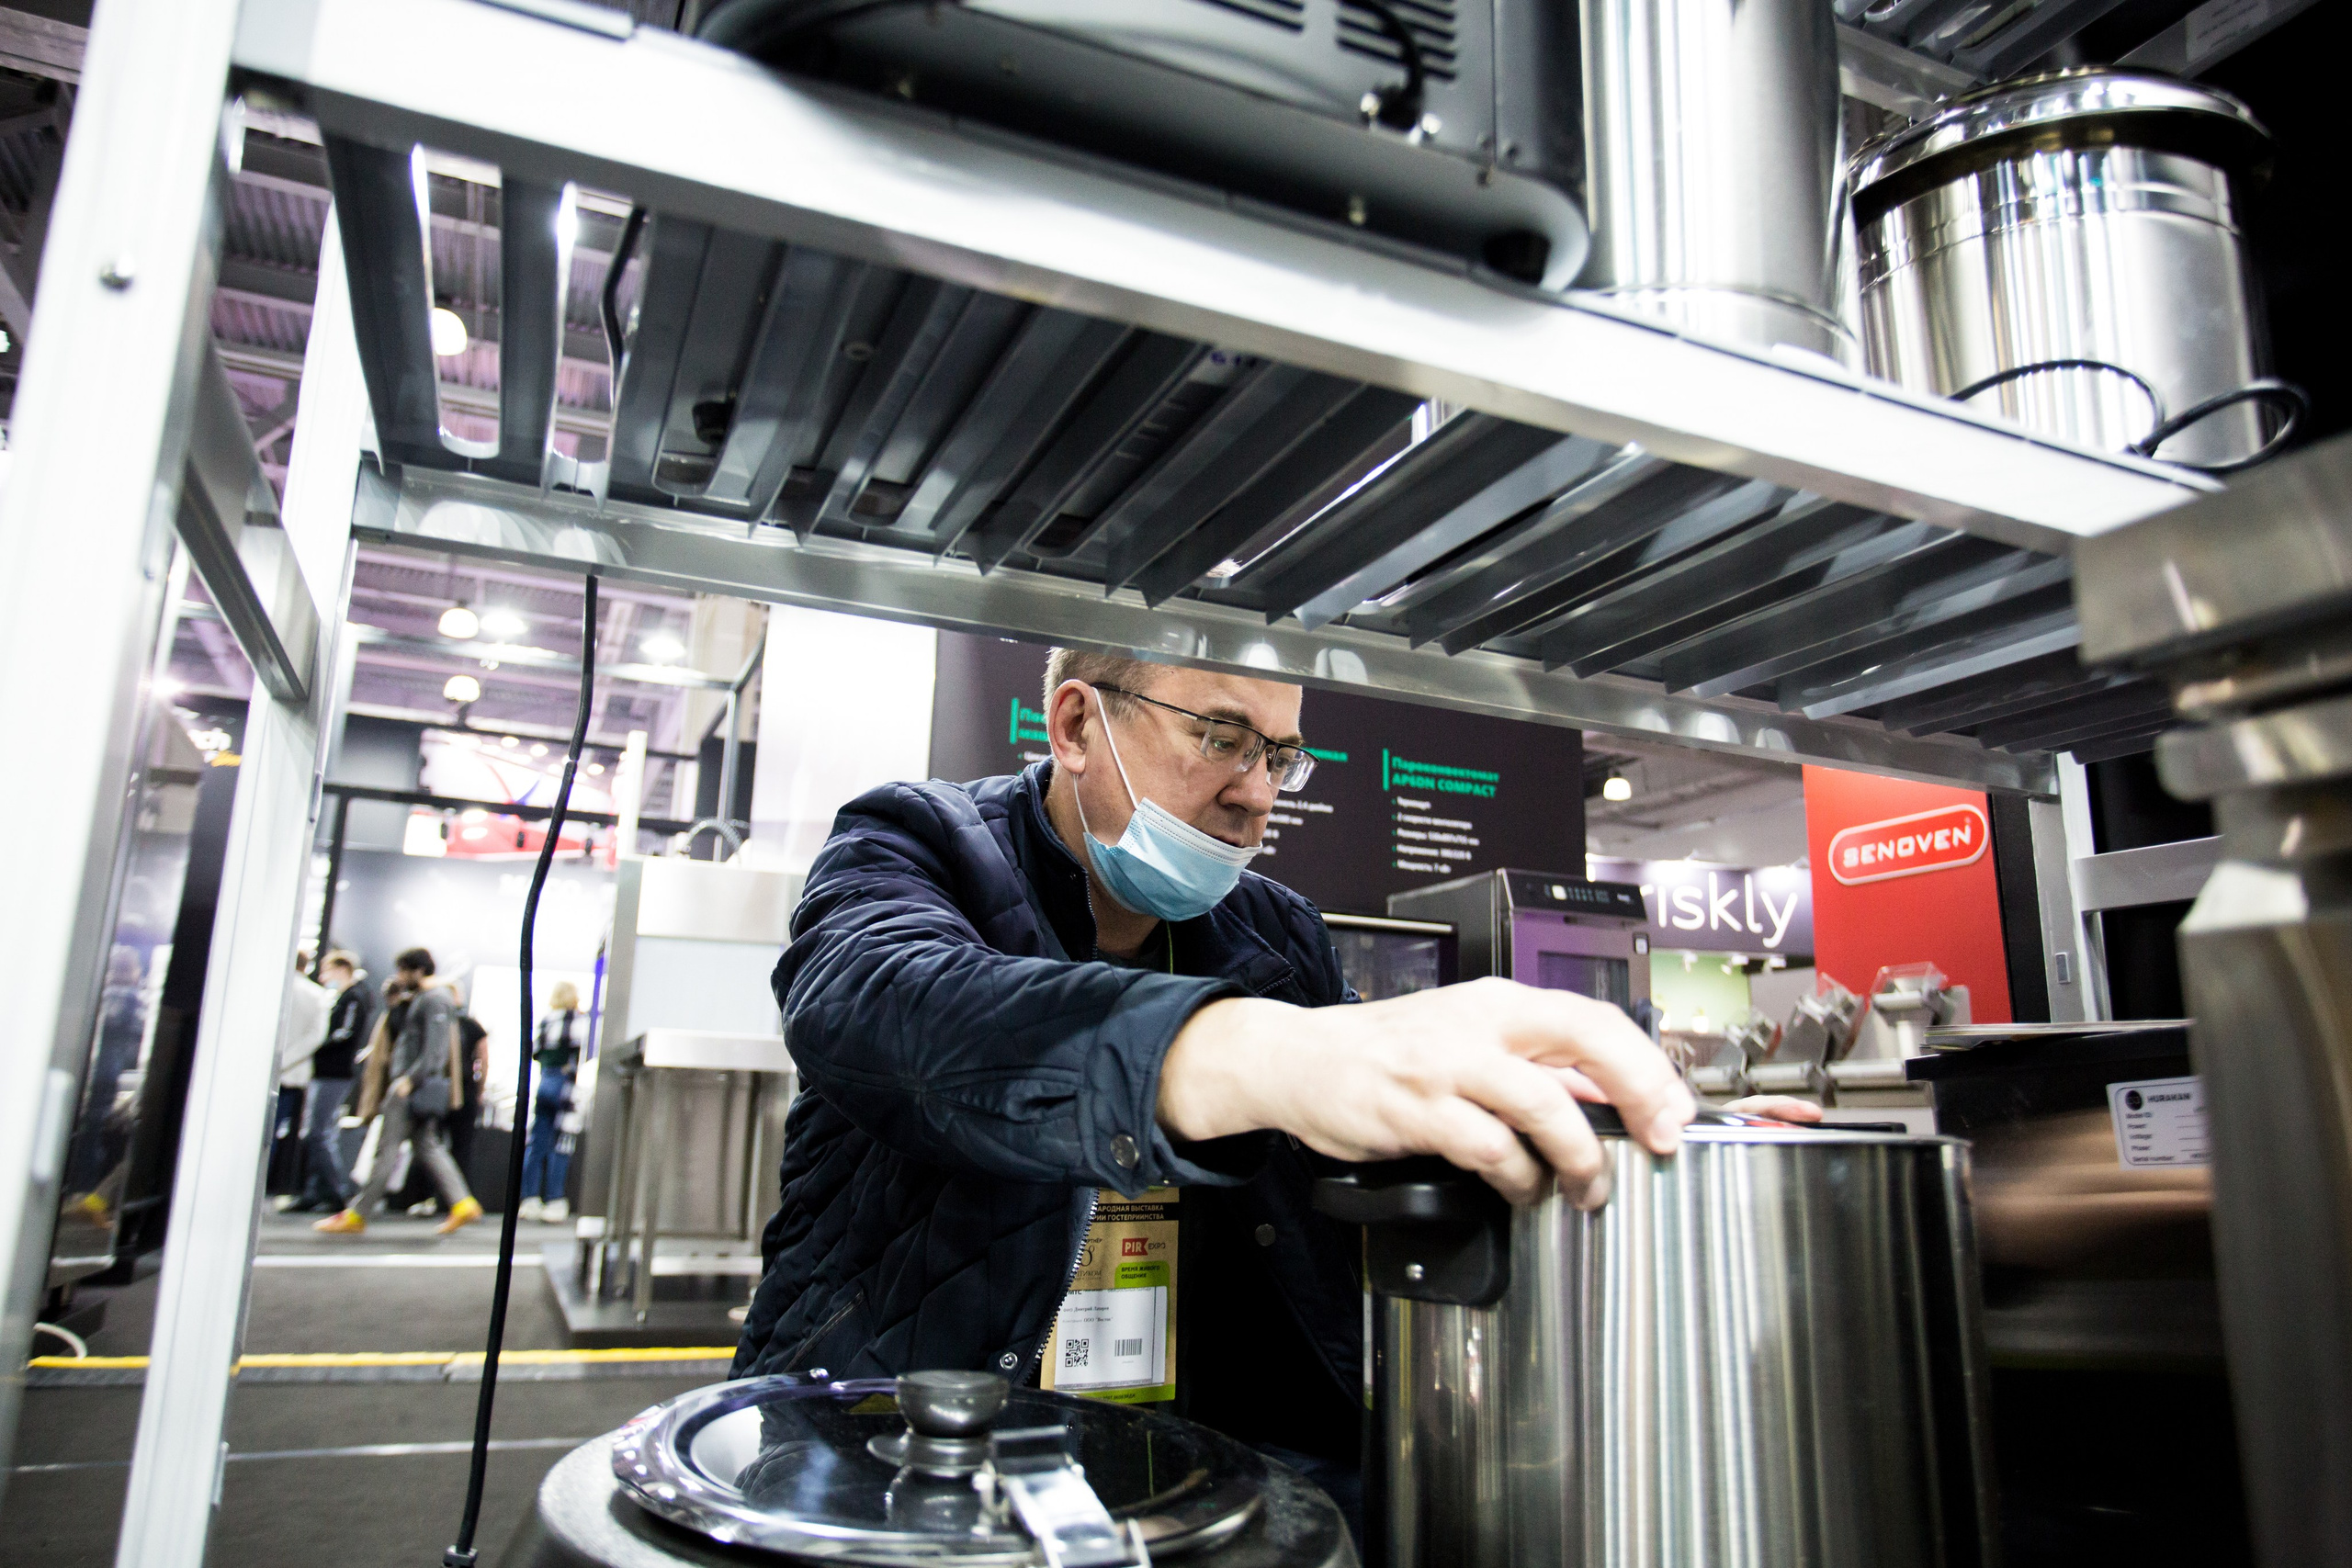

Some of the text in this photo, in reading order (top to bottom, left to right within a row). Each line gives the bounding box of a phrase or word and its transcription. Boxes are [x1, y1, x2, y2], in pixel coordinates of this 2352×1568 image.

[2147, 1093, 2191, 1103] HURAKAN
[1097, 1204, 1164, 1213] АРОДНАЯ ВЫСТАВКА
[1107, 1213, 1165, 1222] ГОСТЕПРИИМСТВА
[1125, 1241, 1166, 1254] PIR EXPO
